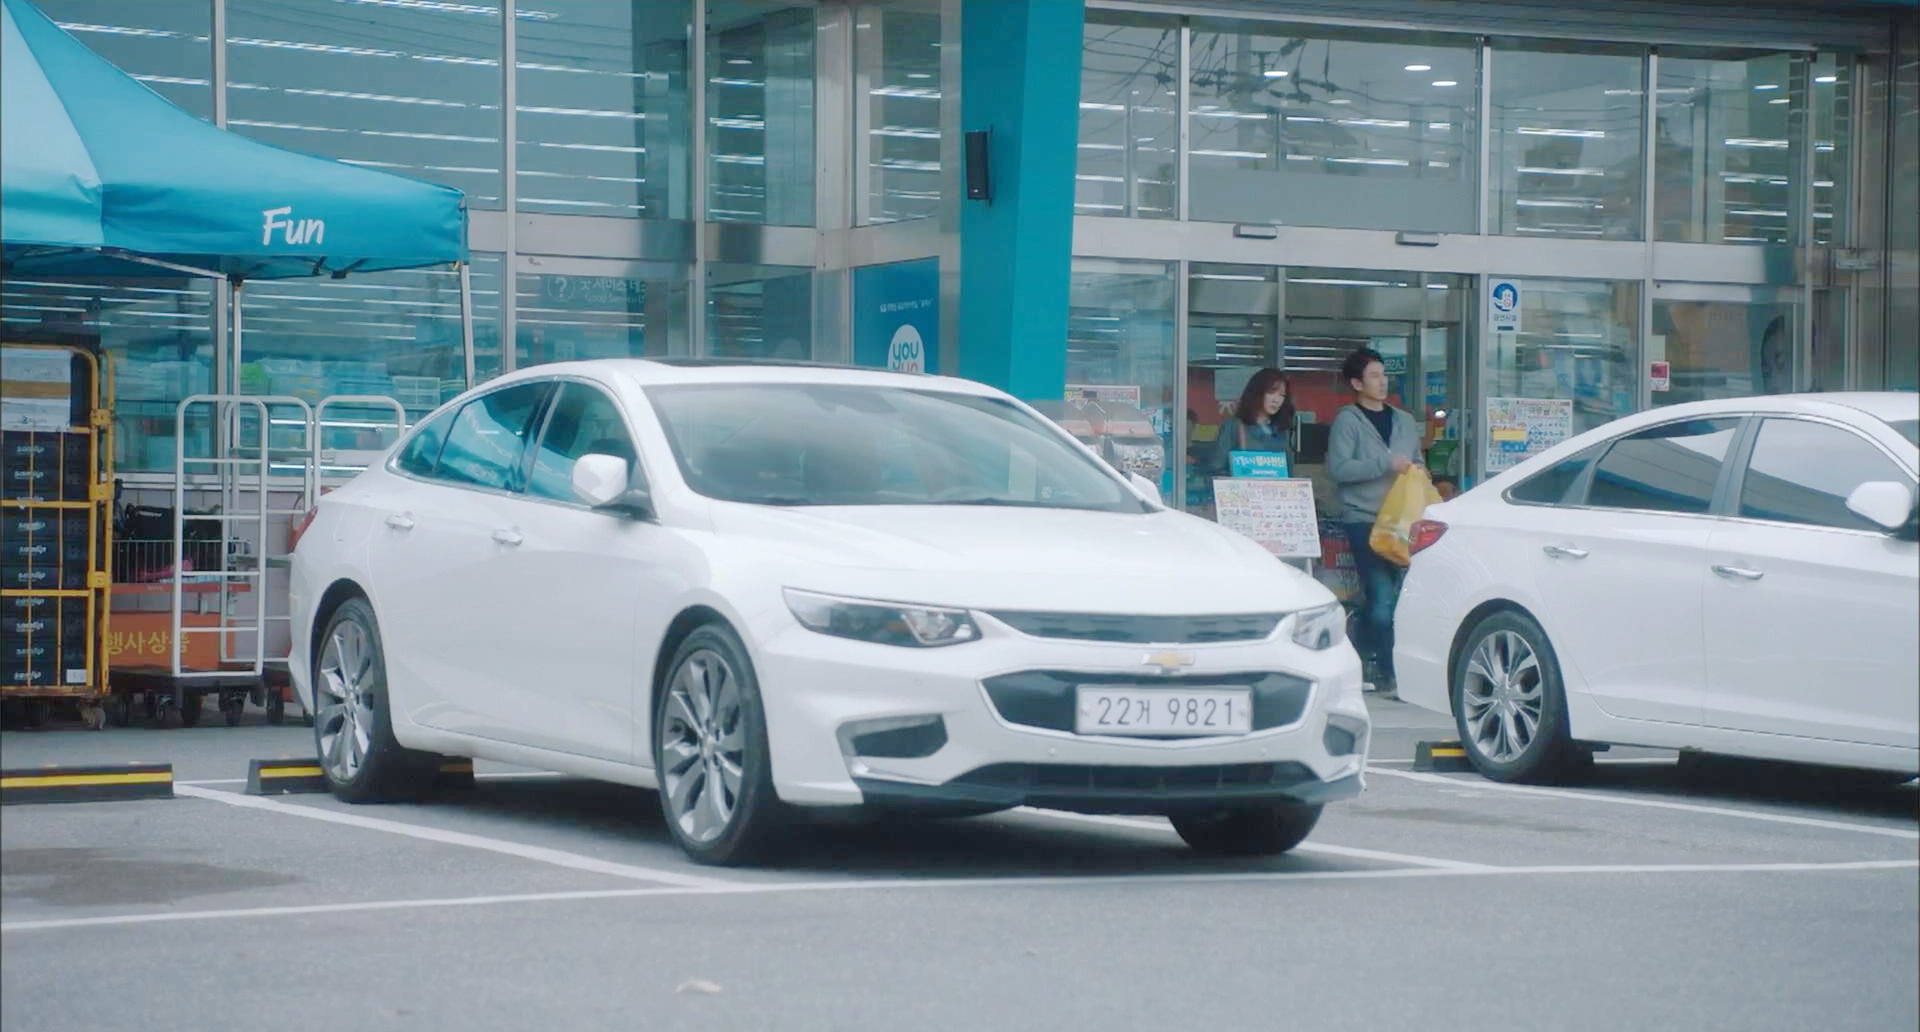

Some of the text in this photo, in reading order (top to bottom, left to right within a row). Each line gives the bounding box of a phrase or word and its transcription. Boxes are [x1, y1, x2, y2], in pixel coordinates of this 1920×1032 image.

[263, 205, 324, 245] Fun
[892, 341, 919, 363] you
[1167, 698, 1233, 726] 9821
